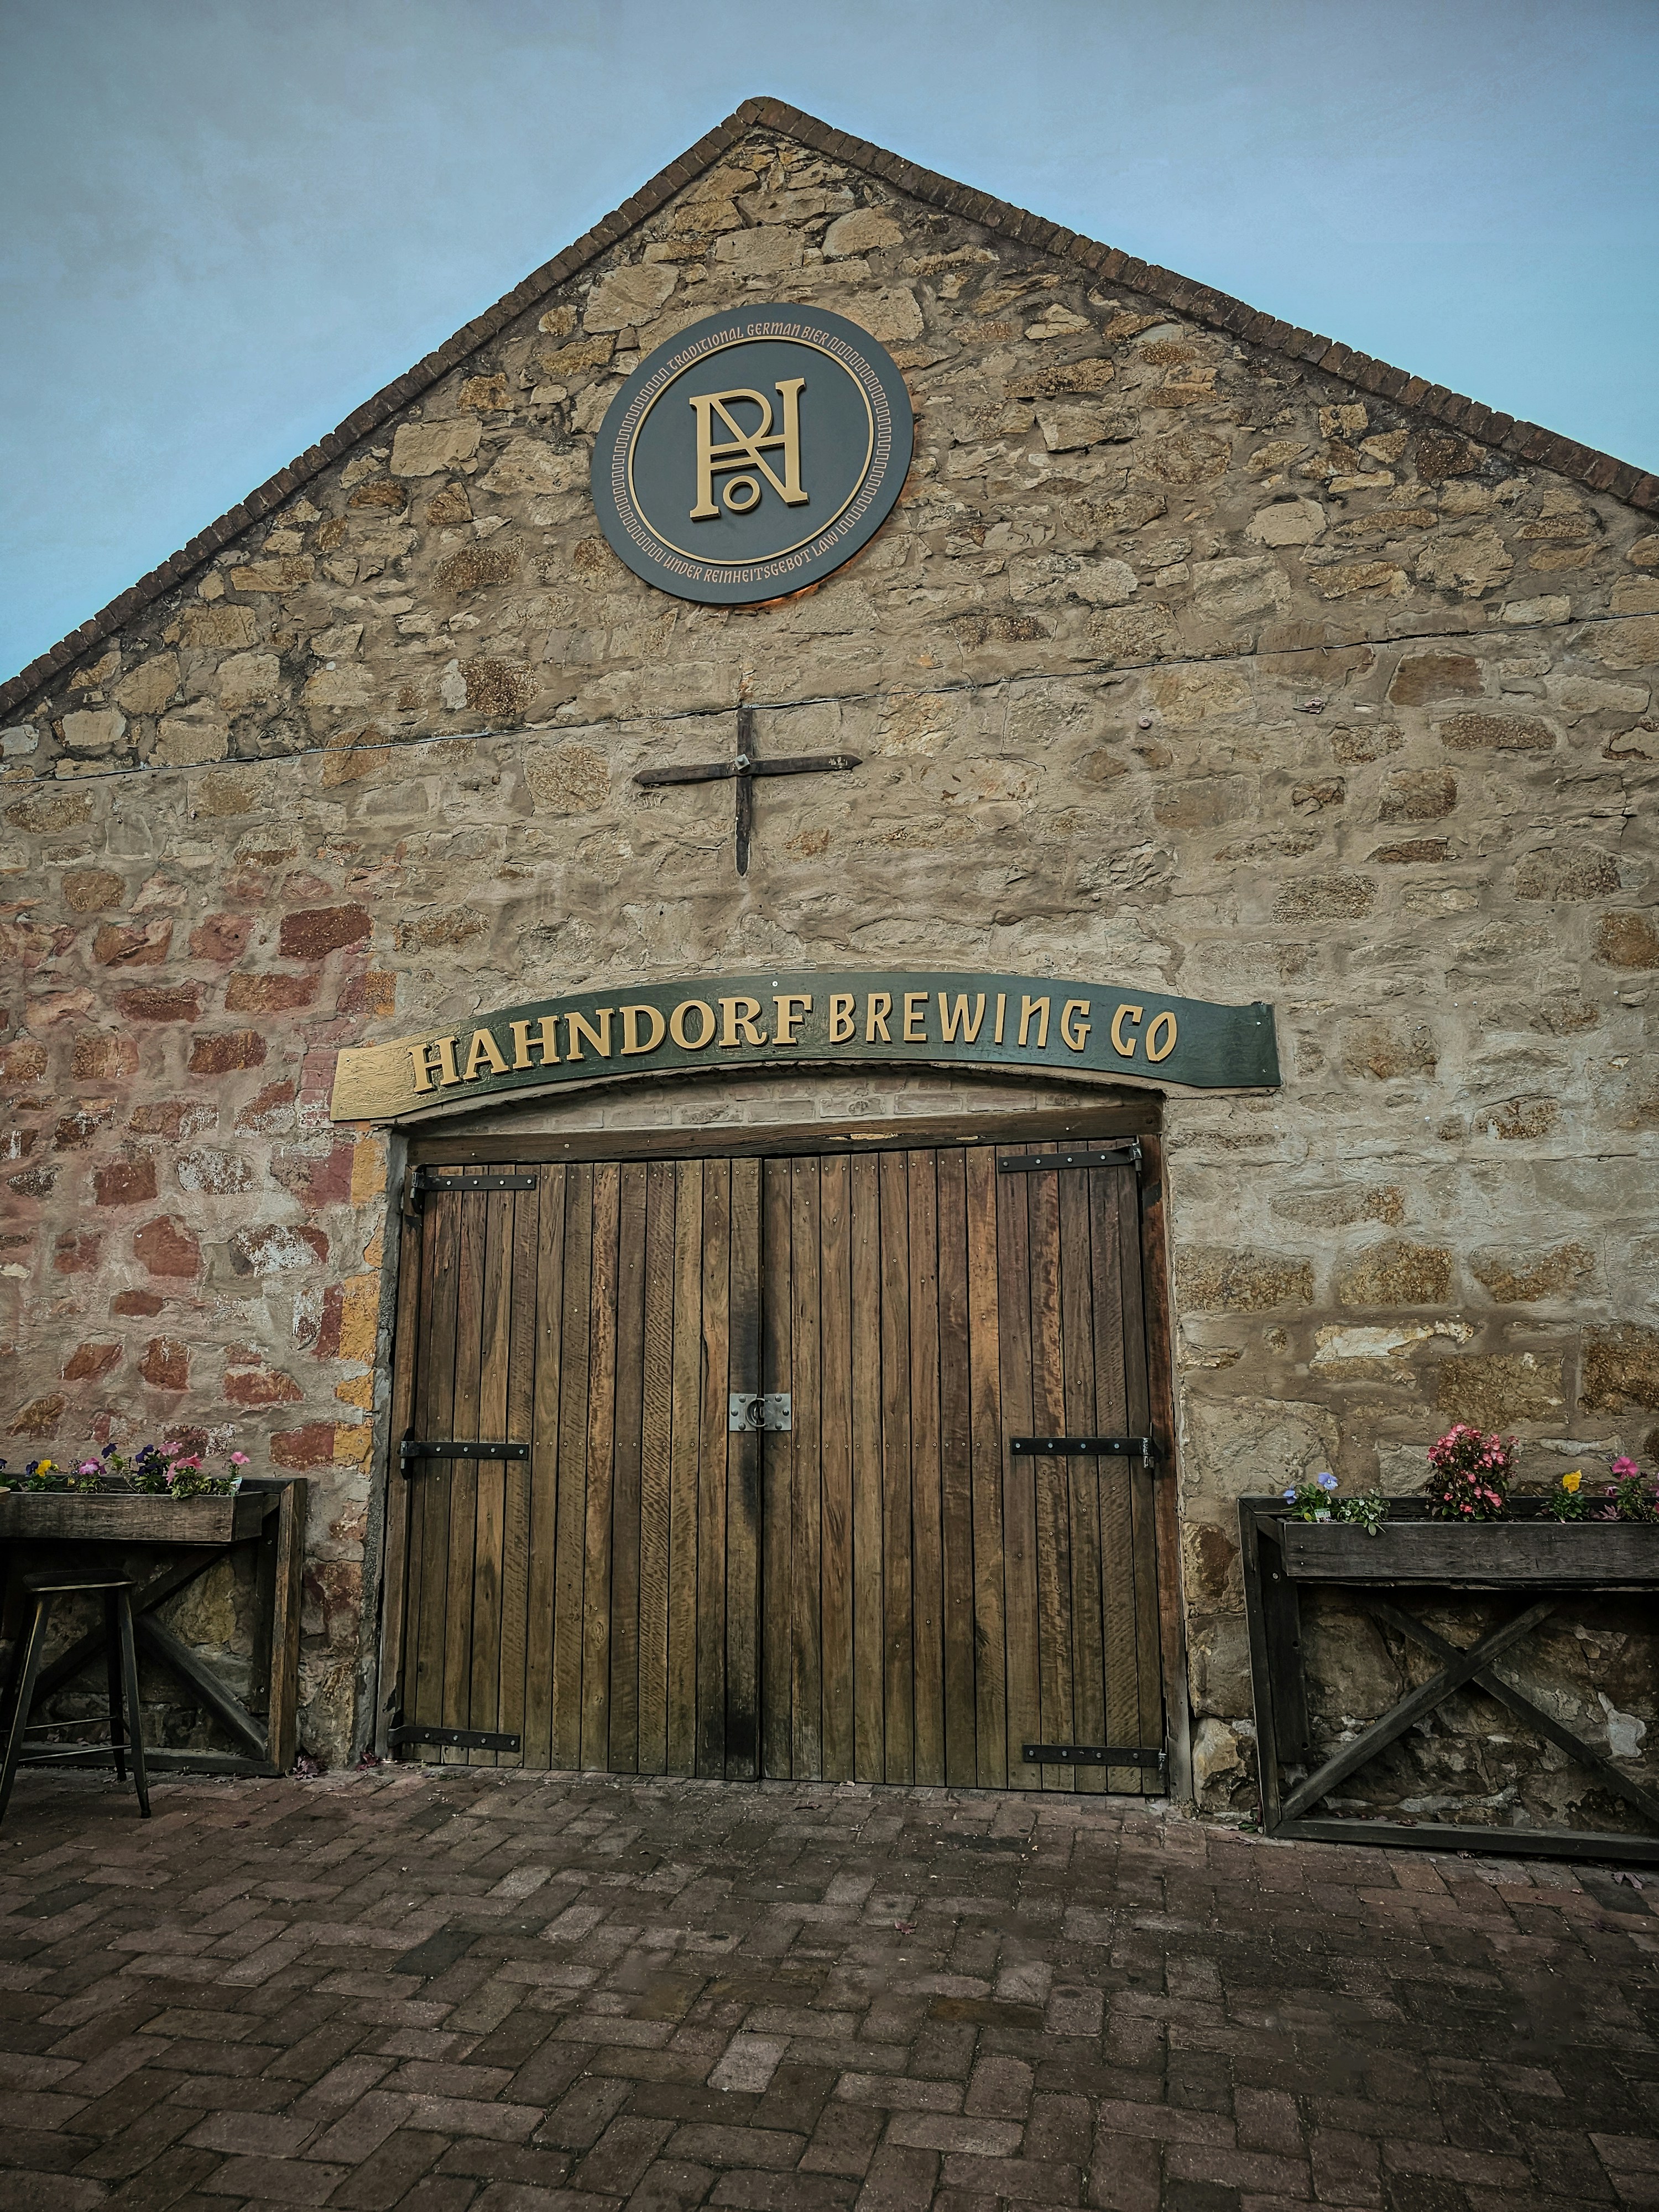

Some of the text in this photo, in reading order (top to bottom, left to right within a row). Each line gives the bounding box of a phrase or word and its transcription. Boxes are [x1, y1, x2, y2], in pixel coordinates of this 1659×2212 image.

[666, 322, 830, 370] TRADITIONAL GERMAN BIER
[664, 531, 838, 583] UNDER REINHEITSGEBOT LAW
[407, 992, 1178, 1093] HAHNDORF BREWING CO
